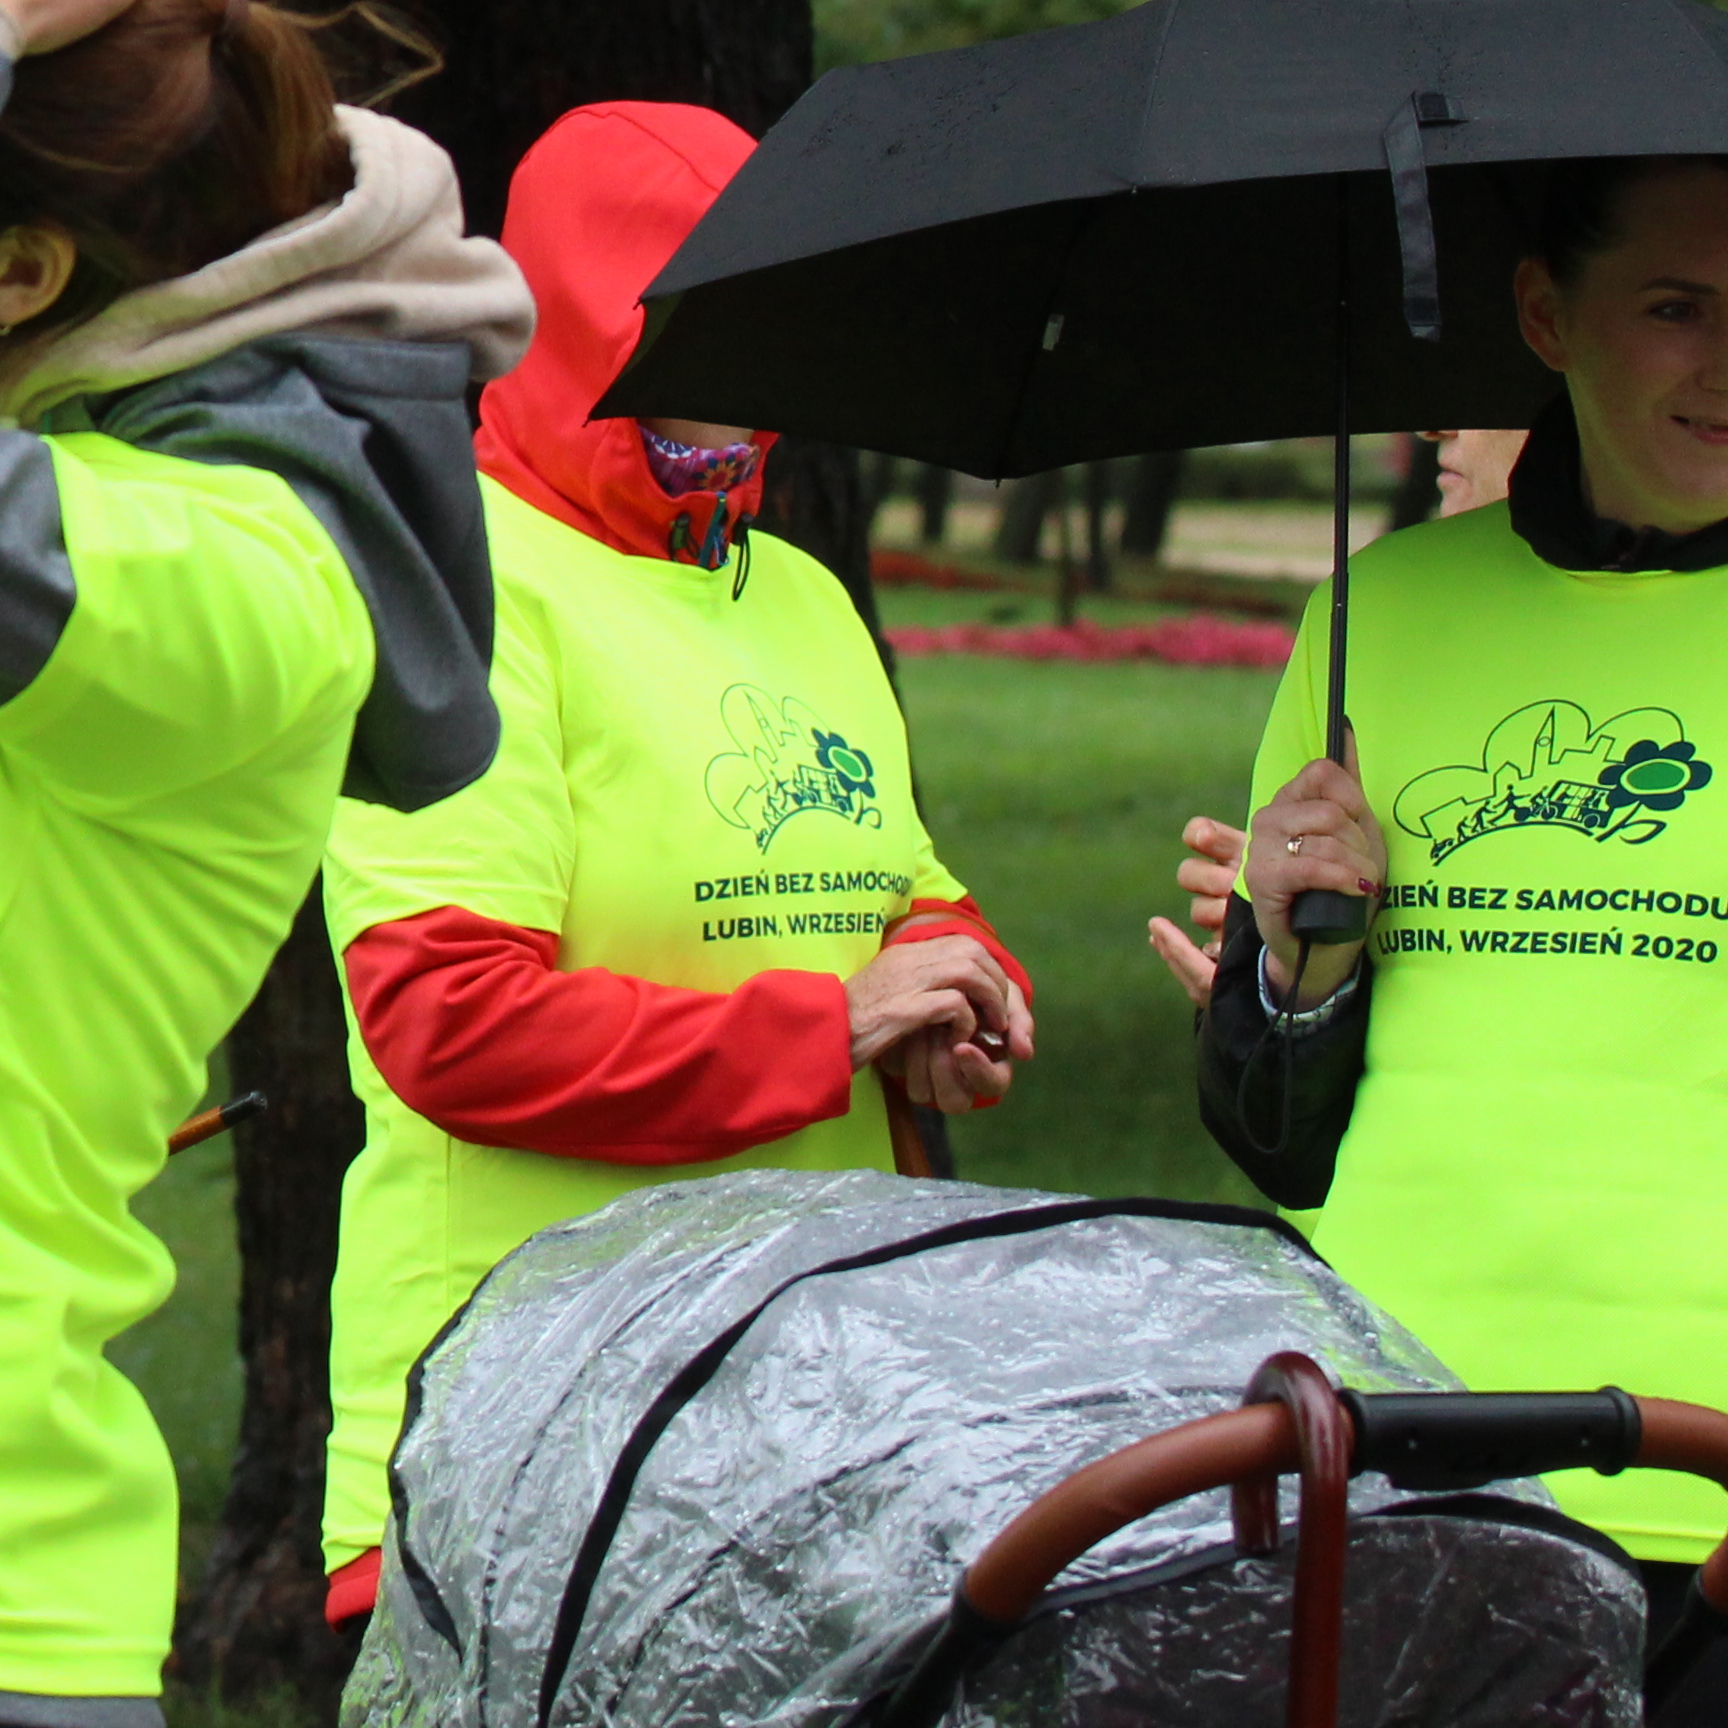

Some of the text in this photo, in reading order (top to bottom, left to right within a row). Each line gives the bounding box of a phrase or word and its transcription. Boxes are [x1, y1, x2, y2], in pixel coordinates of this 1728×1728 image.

[694, 868, 770, 903] DZIEŃ
[775, 870, 815, 896] BEZ
[1379, 878, 1728, 922] ZIEŃ BEZ SAMOCHODU
[701, 914, 784, 943] LUBIN,
[1376, 925, 1718, 964] LUBIN, WRZESIEŃ 2020
